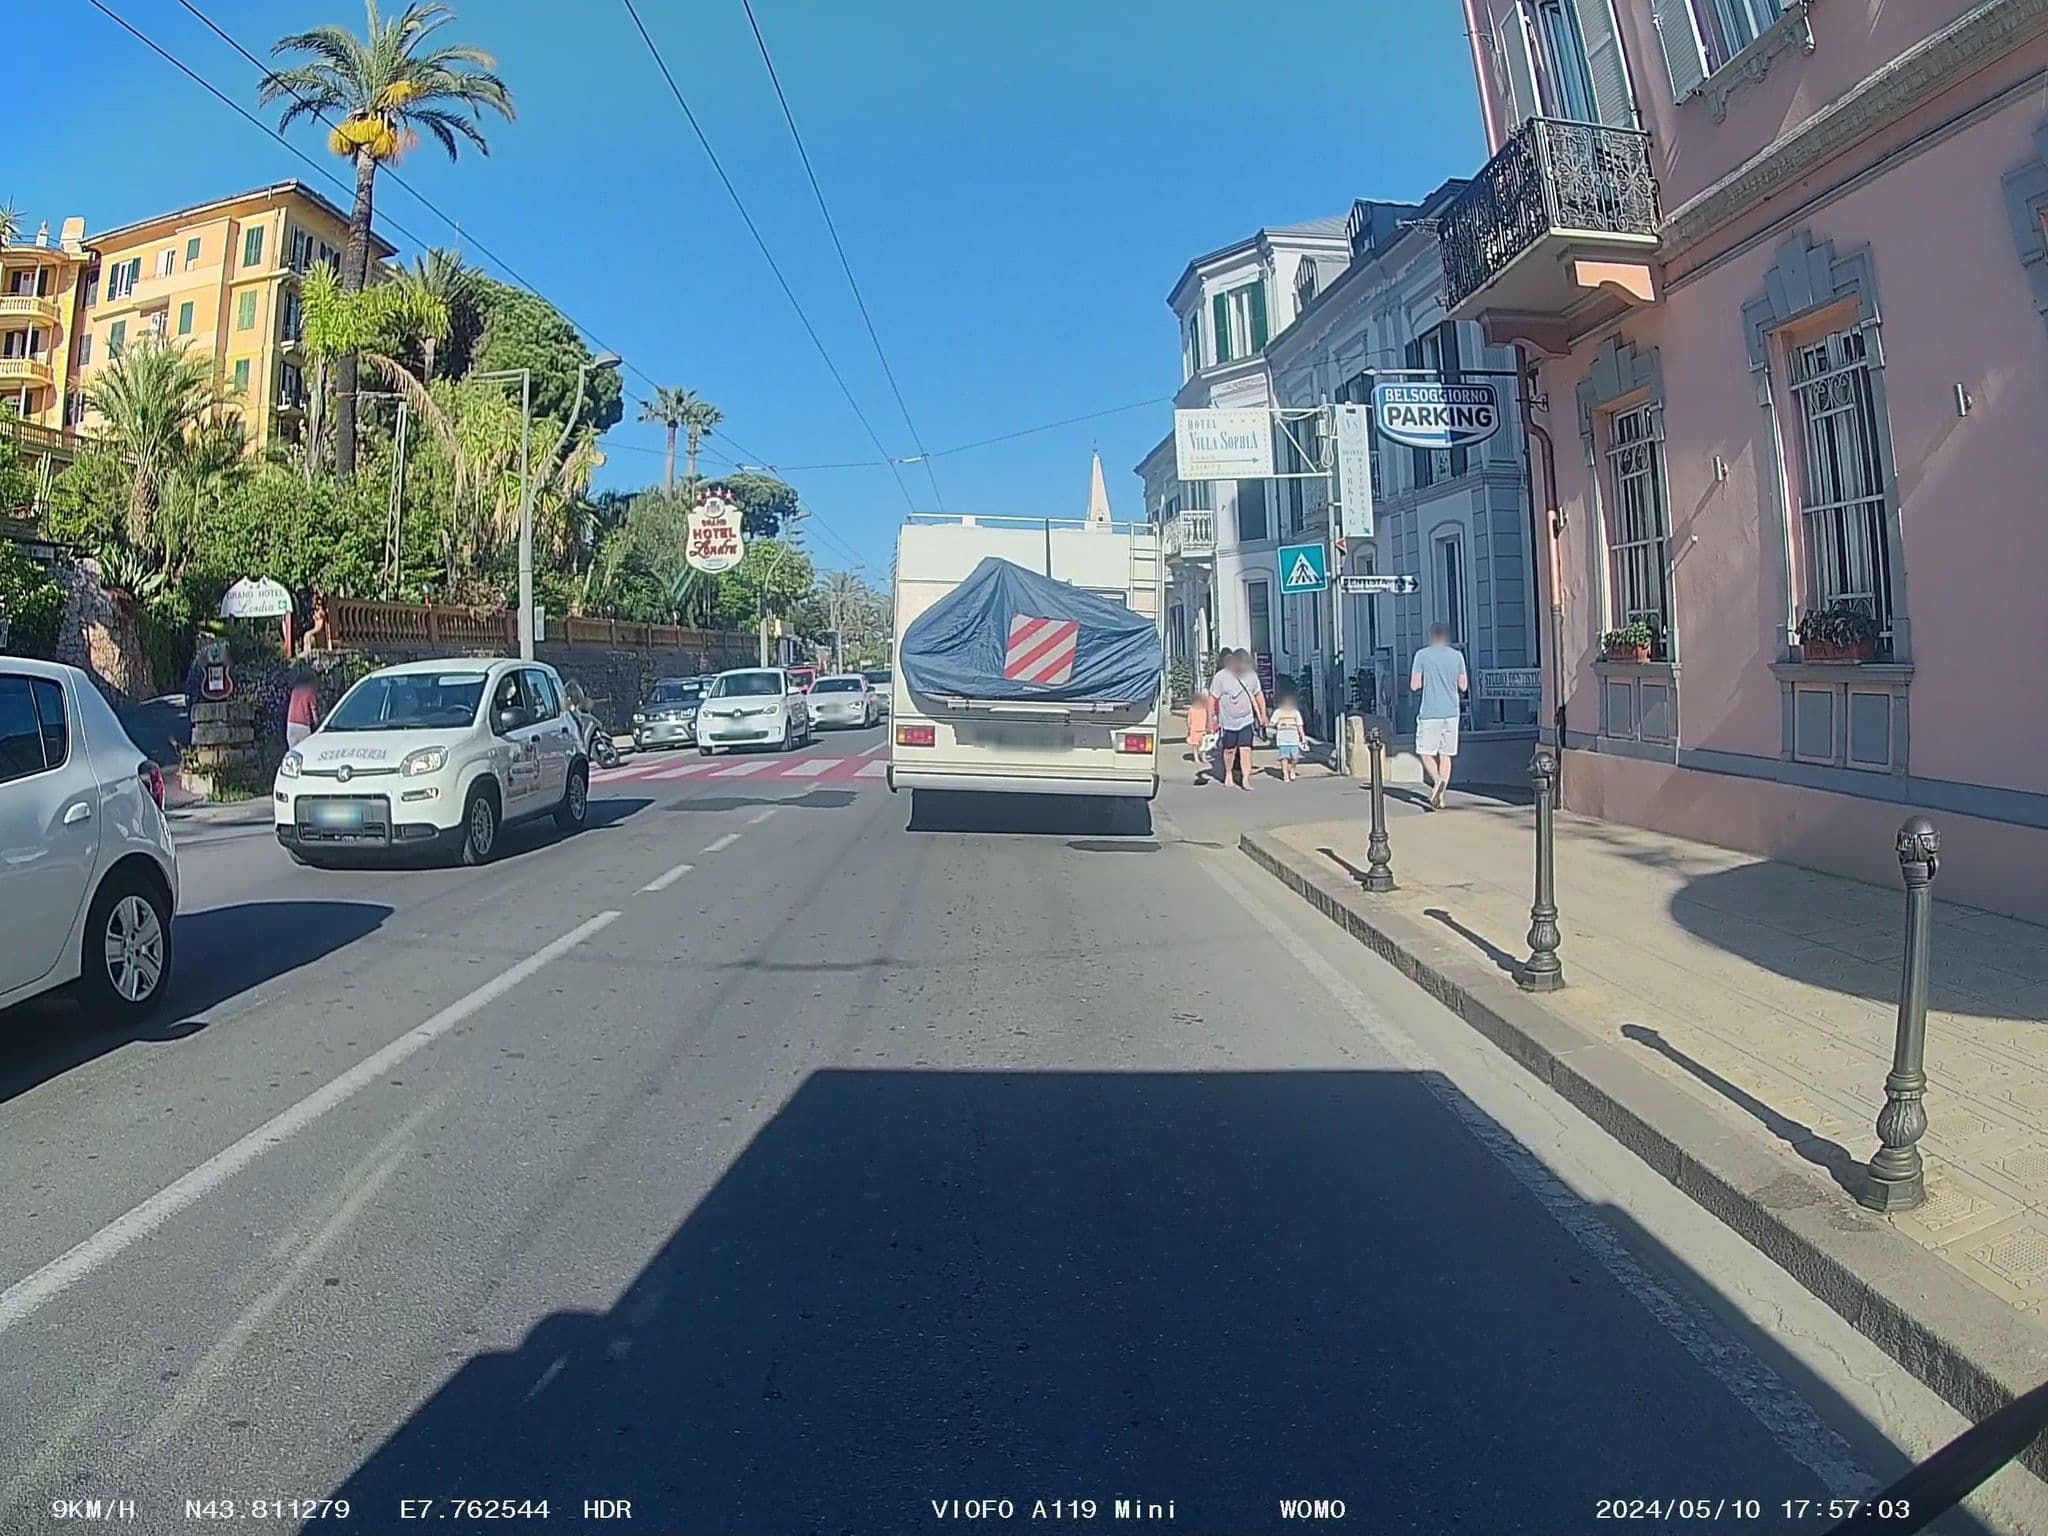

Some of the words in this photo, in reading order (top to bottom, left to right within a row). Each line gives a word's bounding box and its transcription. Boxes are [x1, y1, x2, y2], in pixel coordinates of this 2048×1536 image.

[1384, 388, 1488, 403] BELSOGGIORNO
[1387, 406, 1493, 428] PARKING
[1187, 419, 1216, 430] HOTEL
[1189, 431, 1218, 451] VILLA
[1220, 429, 1258, 451] SOPHIA
[693, 527, 736, 540] HOTEL
[1343, 578, 1387, 587] DENTISTA
[226, 590, 254, 600] GRAND
[258, 588, 285, 599] HOTEL
